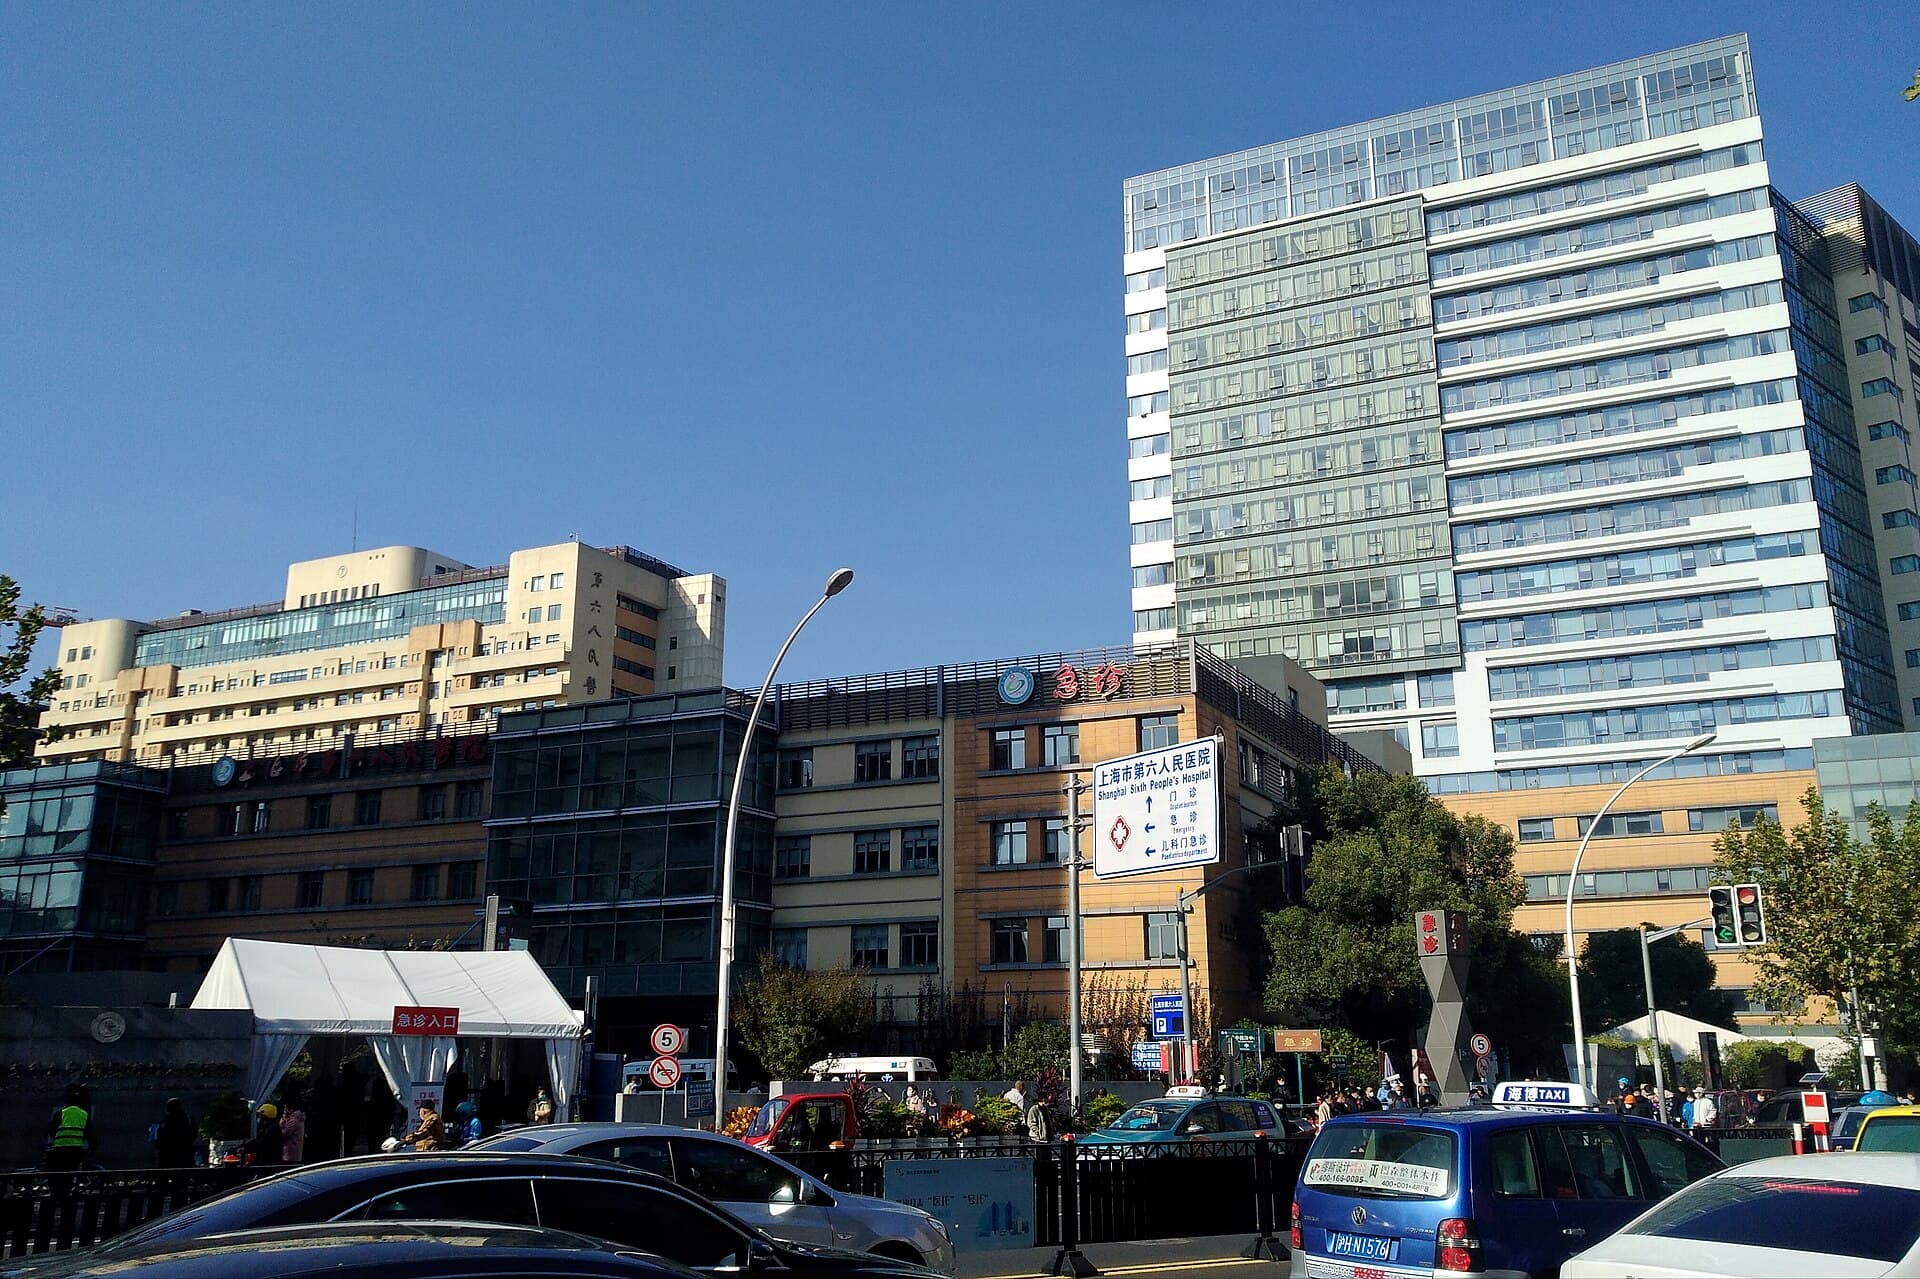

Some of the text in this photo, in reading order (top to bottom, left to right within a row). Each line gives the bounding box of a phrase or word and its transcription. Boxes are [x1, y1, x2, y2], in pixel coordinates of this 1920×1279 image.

[1052, 660, 1125, 699] 急诊
[1098, 747, 1211, 788] 上海市第六人民医院
[1098, 768, 1211, 801] Shanghai Sixth People's Hospital
[1169, 786, 1197, 802] 门诊
[1170, 811, 1198, 826] 急诊
[1161, 833, 1207, 852] 儿科门急诊
[1422, 914, 1439, 954] 急诊
[397, 1013, 457, 1028] 急诊入口
[1158, 1019, 1165, 1032] P
[661, 1031, 673, 1047] 5
[1284, 1037, 1313, 1047] 急诊
[1477, 1039, 1485, 1050] 5
